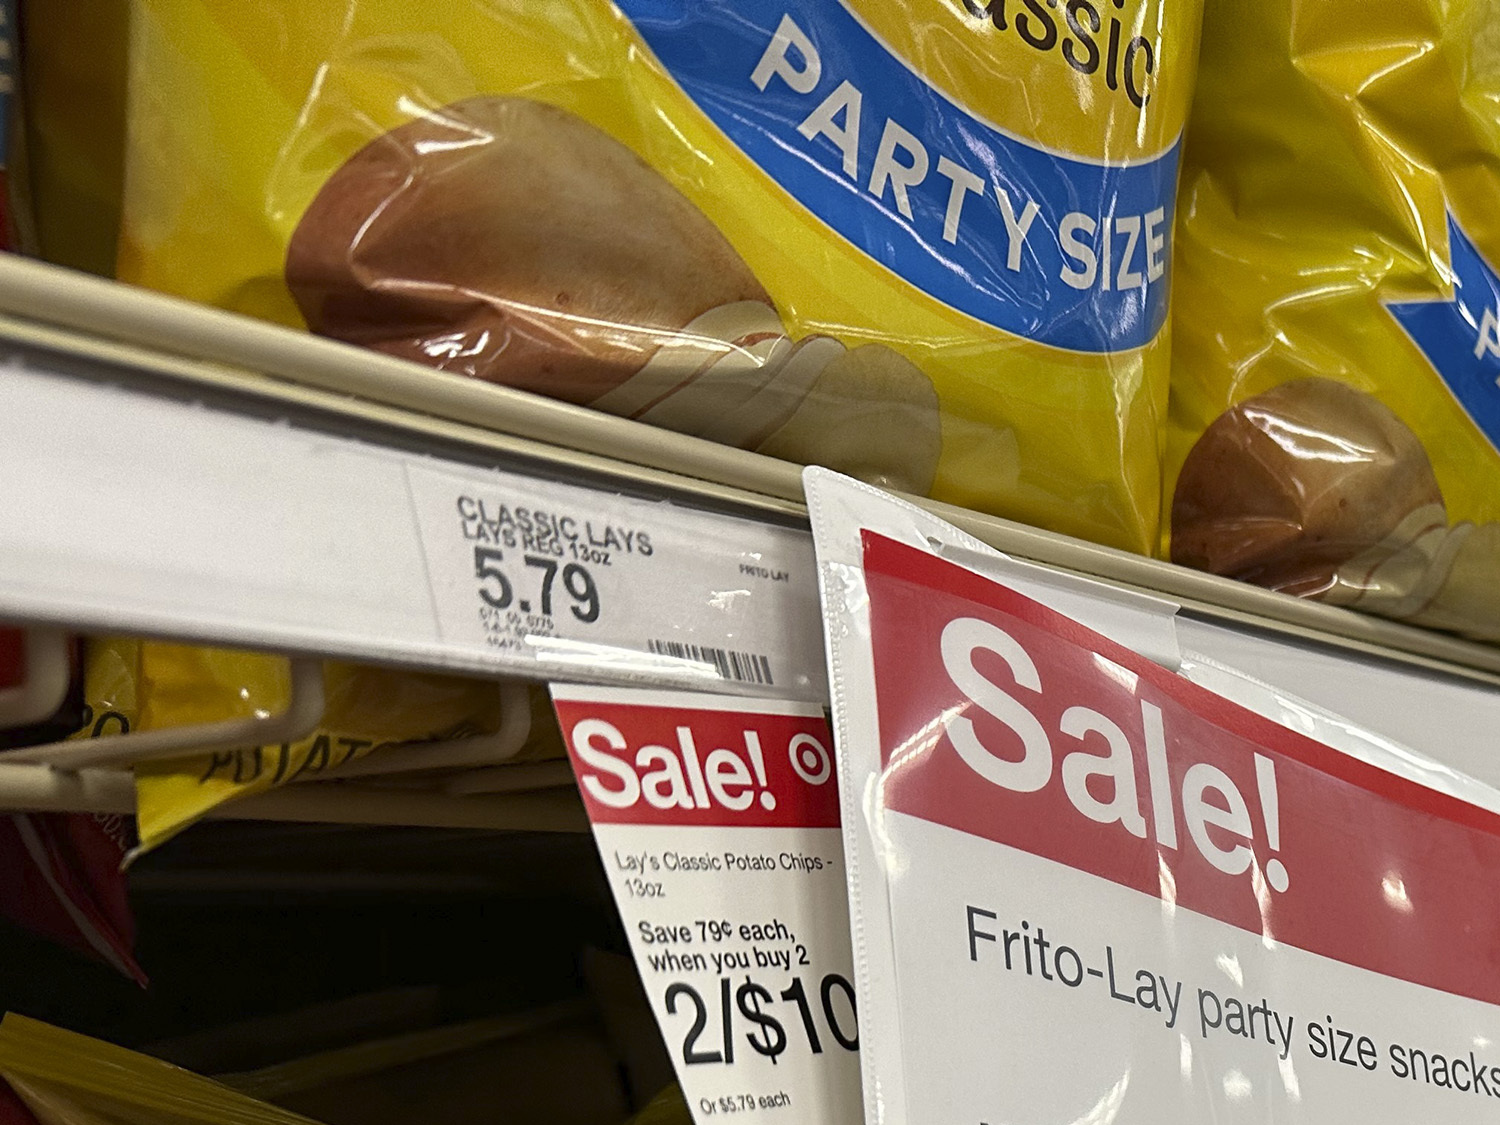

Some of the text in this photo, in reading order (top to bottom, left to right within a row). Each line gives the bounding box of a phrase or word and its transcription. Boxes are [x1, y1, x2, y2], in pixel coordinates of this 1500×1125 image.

[962, 0, 1153, 108] ssic
[750, 14, 1166, 293] PARTY SIZE
[457, 495, 654, 557] CLASSIC LAYS
[462, 519, 517, 549] LAYS
[522, 533, 565, 558] REG
[474, 546, 602, 623] 5.79
[738, 563, 790, 582] FRITO LAY
[571, 718, 778, 812] Sale!
[941, 616, 1290, 893] Sale!
[615, 849, 661, 875] Lay's
[662, 851, 722, 872] Classic
[723, 851, 776, 872] Potato
[778, 851, 824, 874] Chips
[625, 877, 667, 898] 13oz
[638, 918, 797, 945] Save 79¢ each,
[647, 944, 811, 975] when you buy 2
[664, 971, 861, 1066] 2/$10
[965, 904, 1182, 1029] Frito-Lay
[1197, 987, 1295, 1061] party
[1306, 1014, 1379, 1072] size
[700, 1091, 792, 1116] Or $5.79 each
